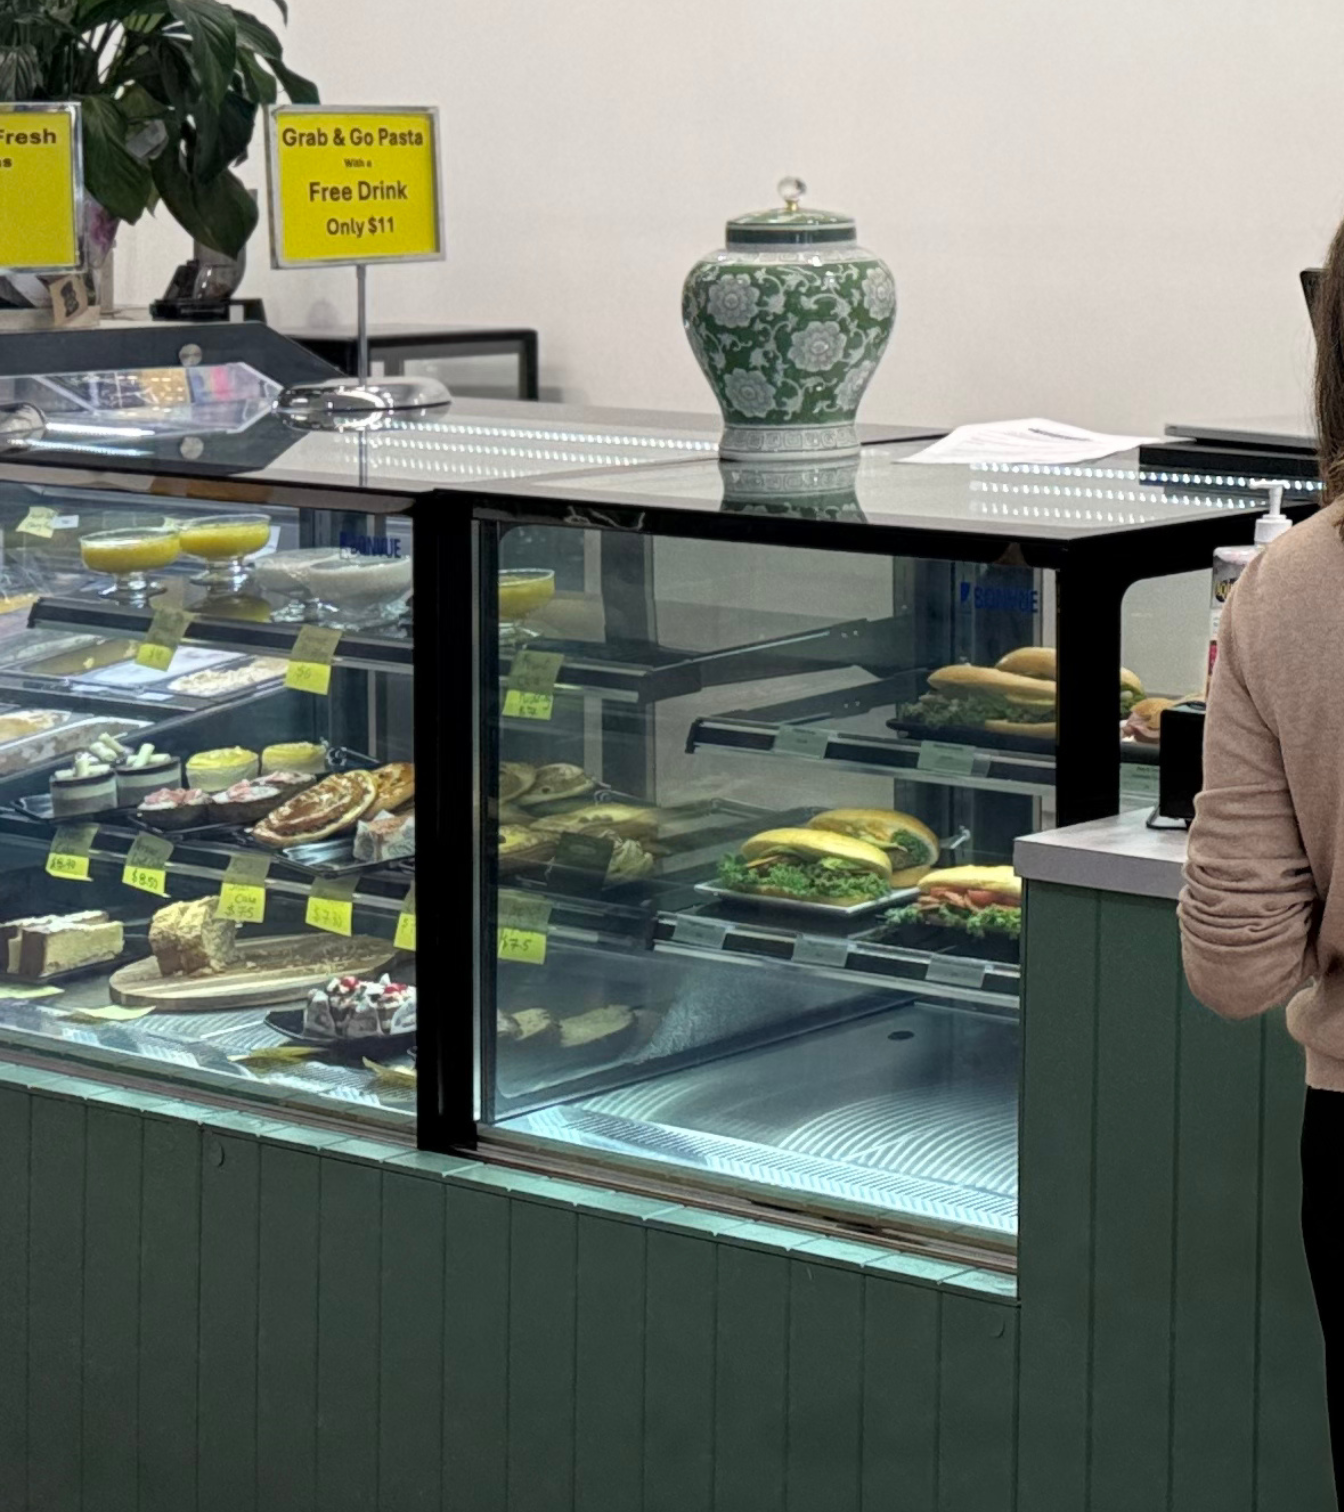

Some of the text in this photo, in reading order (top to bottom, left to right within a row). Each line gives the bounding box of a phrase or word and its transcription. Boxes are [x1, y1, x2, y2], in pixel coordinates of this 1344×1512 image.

[282, 127, 423, 148] Grab & Go Pasta
[309, 181, 407, 201] Free Drink
[327, 216, 395, 239] Only $11
